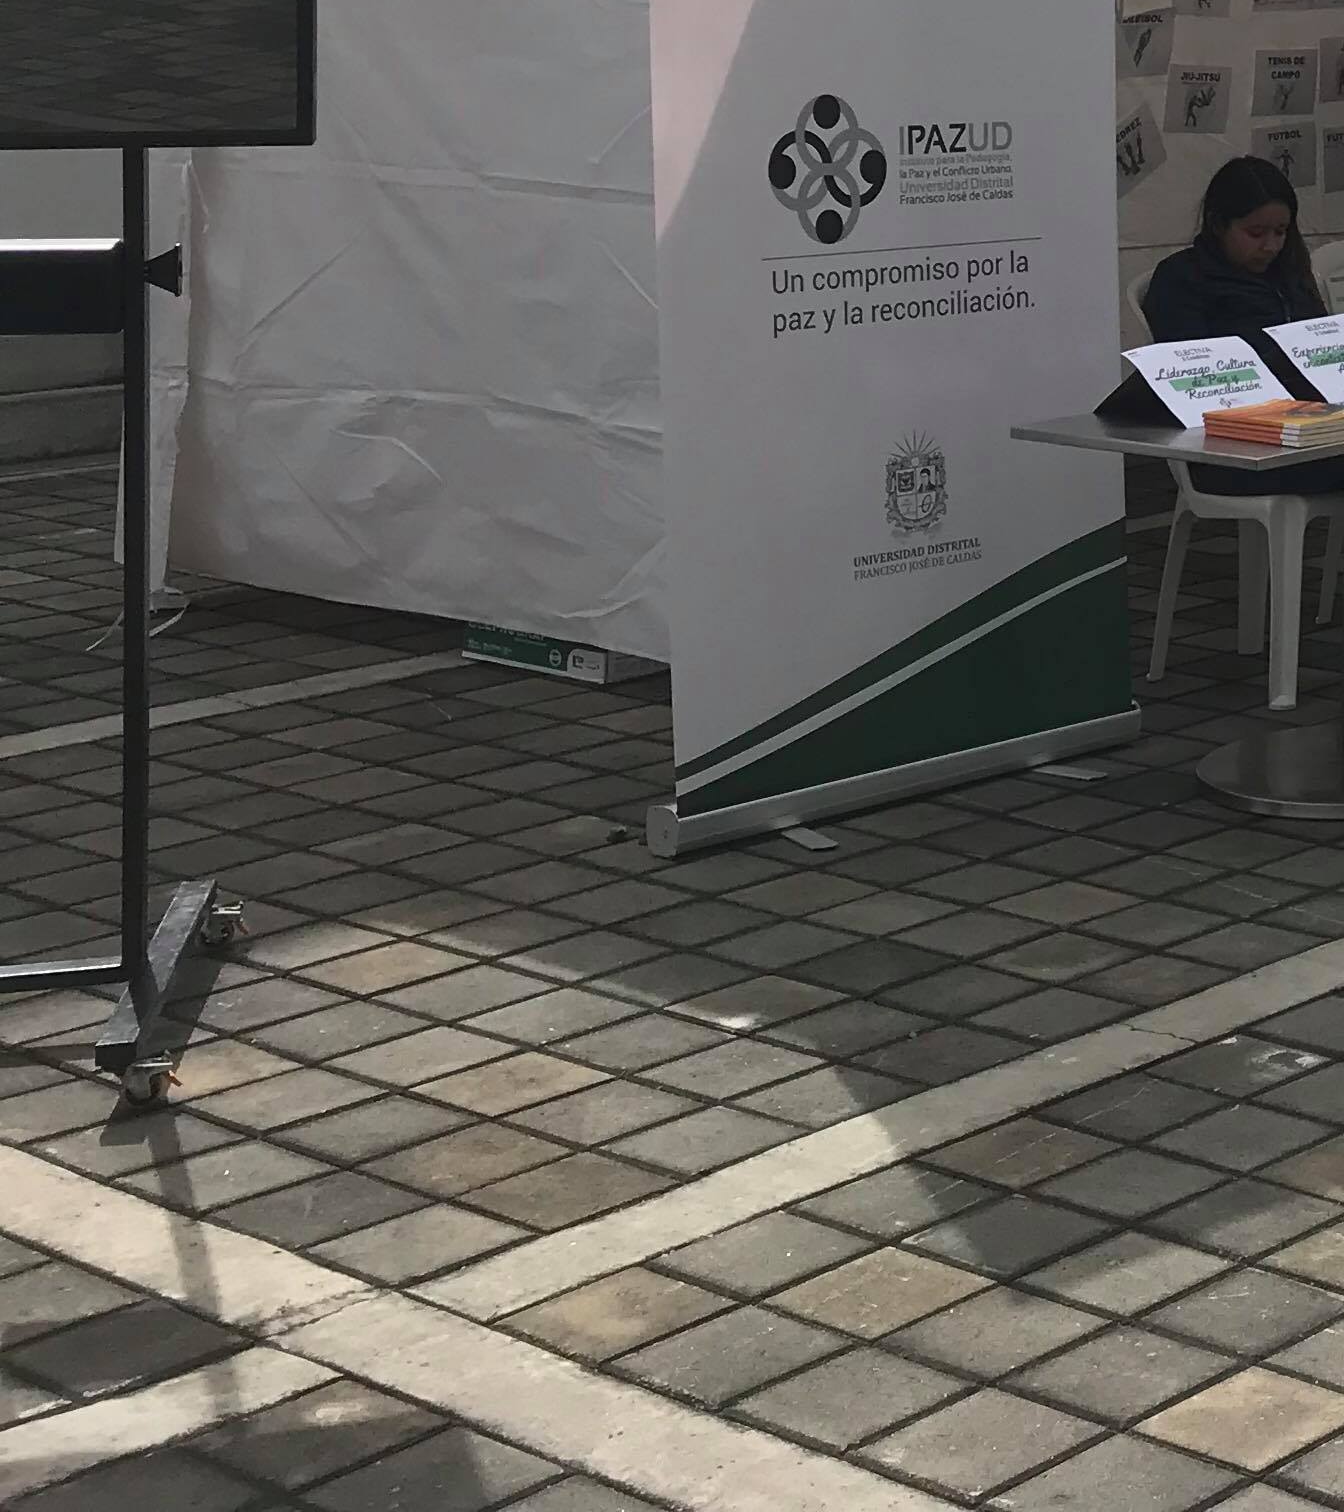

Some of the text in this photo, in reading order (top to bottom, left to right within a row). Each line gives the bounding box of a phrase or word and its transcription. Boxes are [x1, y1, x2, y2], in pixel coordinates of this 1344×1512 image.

[1268, 56, 1305, 66] TENIS DE
[1271, 71, 1301, 80] CAMPO
[899, 121, 1013, 155] IPAZUD
[909, 169, 924, 178] Paz
[926, 171, 931, 179] y
[933, 167, 940, 177] el
[943, 165, 979, 177] Conflicto
[900, 175, 1014, 193] Universidad Distrital
[899, 188, 1013, 205] Francisco José de Caldas
[772, 250, 1029, 294] Un compromiso por la
[773, 285, 1036, 338] paz y la reconciliación.
[1216, 357, 1257, 372] Cultura
[1191, 376, 1202, 388] de
[1207, 373, 1228, 385] Paz
[1185, 382, 1262, 400] Reconciliación
[854, 537, 980, 567] UNIVERSIDAD DISTRITAL
[854, 551, 982, 580] FRANCISCO JOSÉ DE CALDAS
